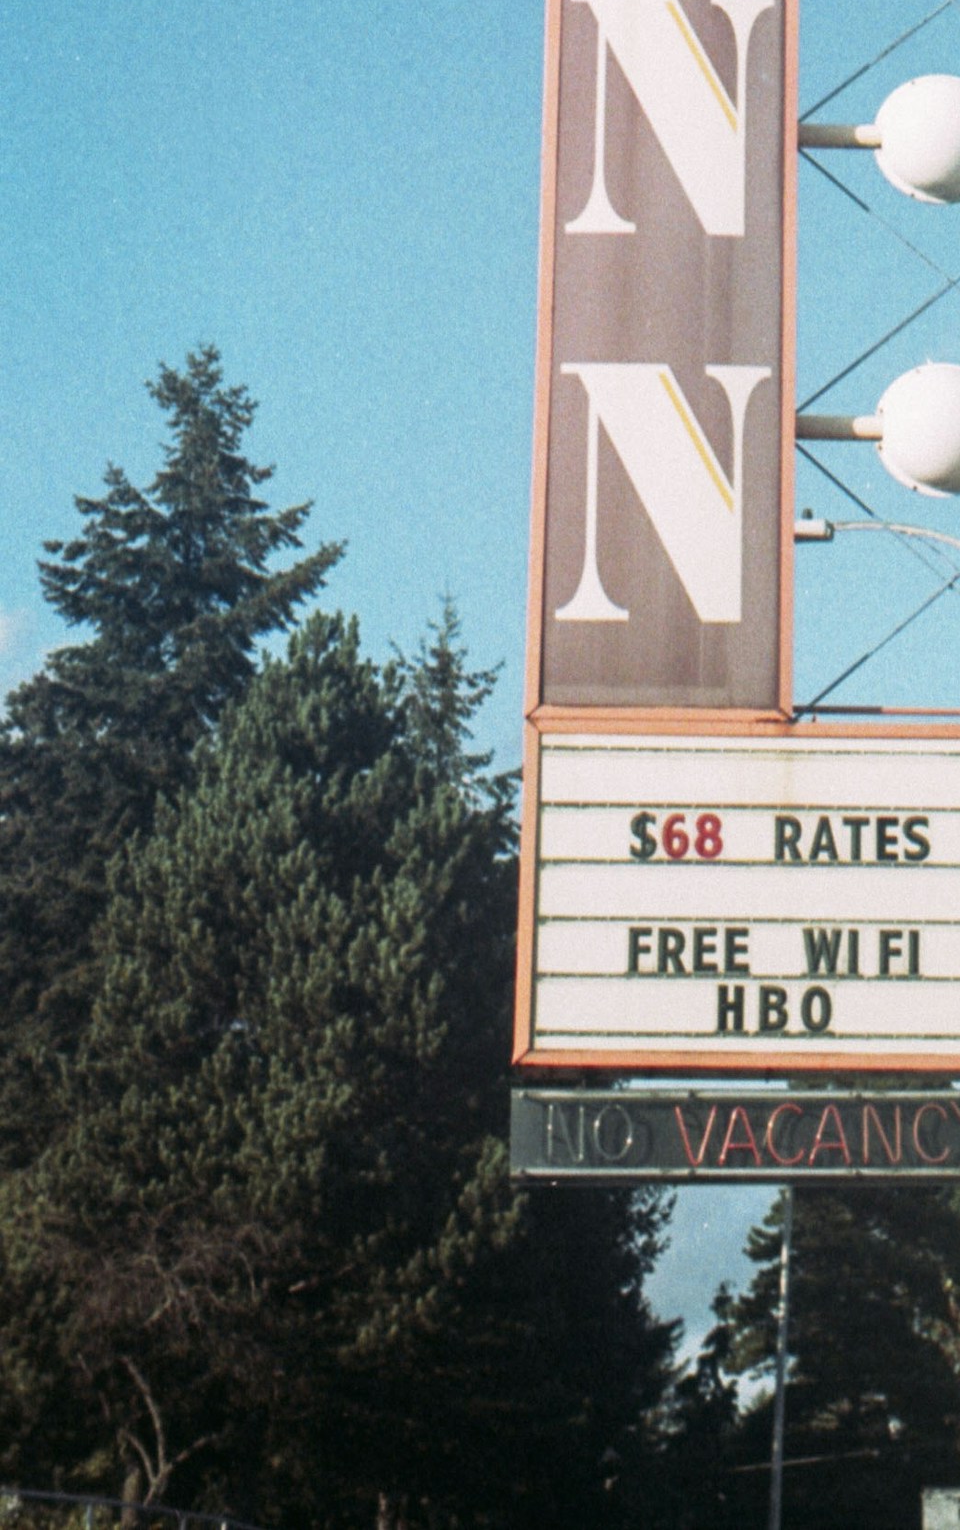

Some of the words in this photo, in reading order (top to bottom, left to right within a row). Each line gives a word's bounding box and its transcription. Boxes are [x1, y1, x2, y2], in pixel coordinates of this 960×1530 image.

[629, 811, 723, 861] $68
[774, 815, 931, 862] RATES
[627, 927, 750, 974] FREE
[716, 985, 833, 1033] HBO
[545, 1104, 634, 1162] NO
